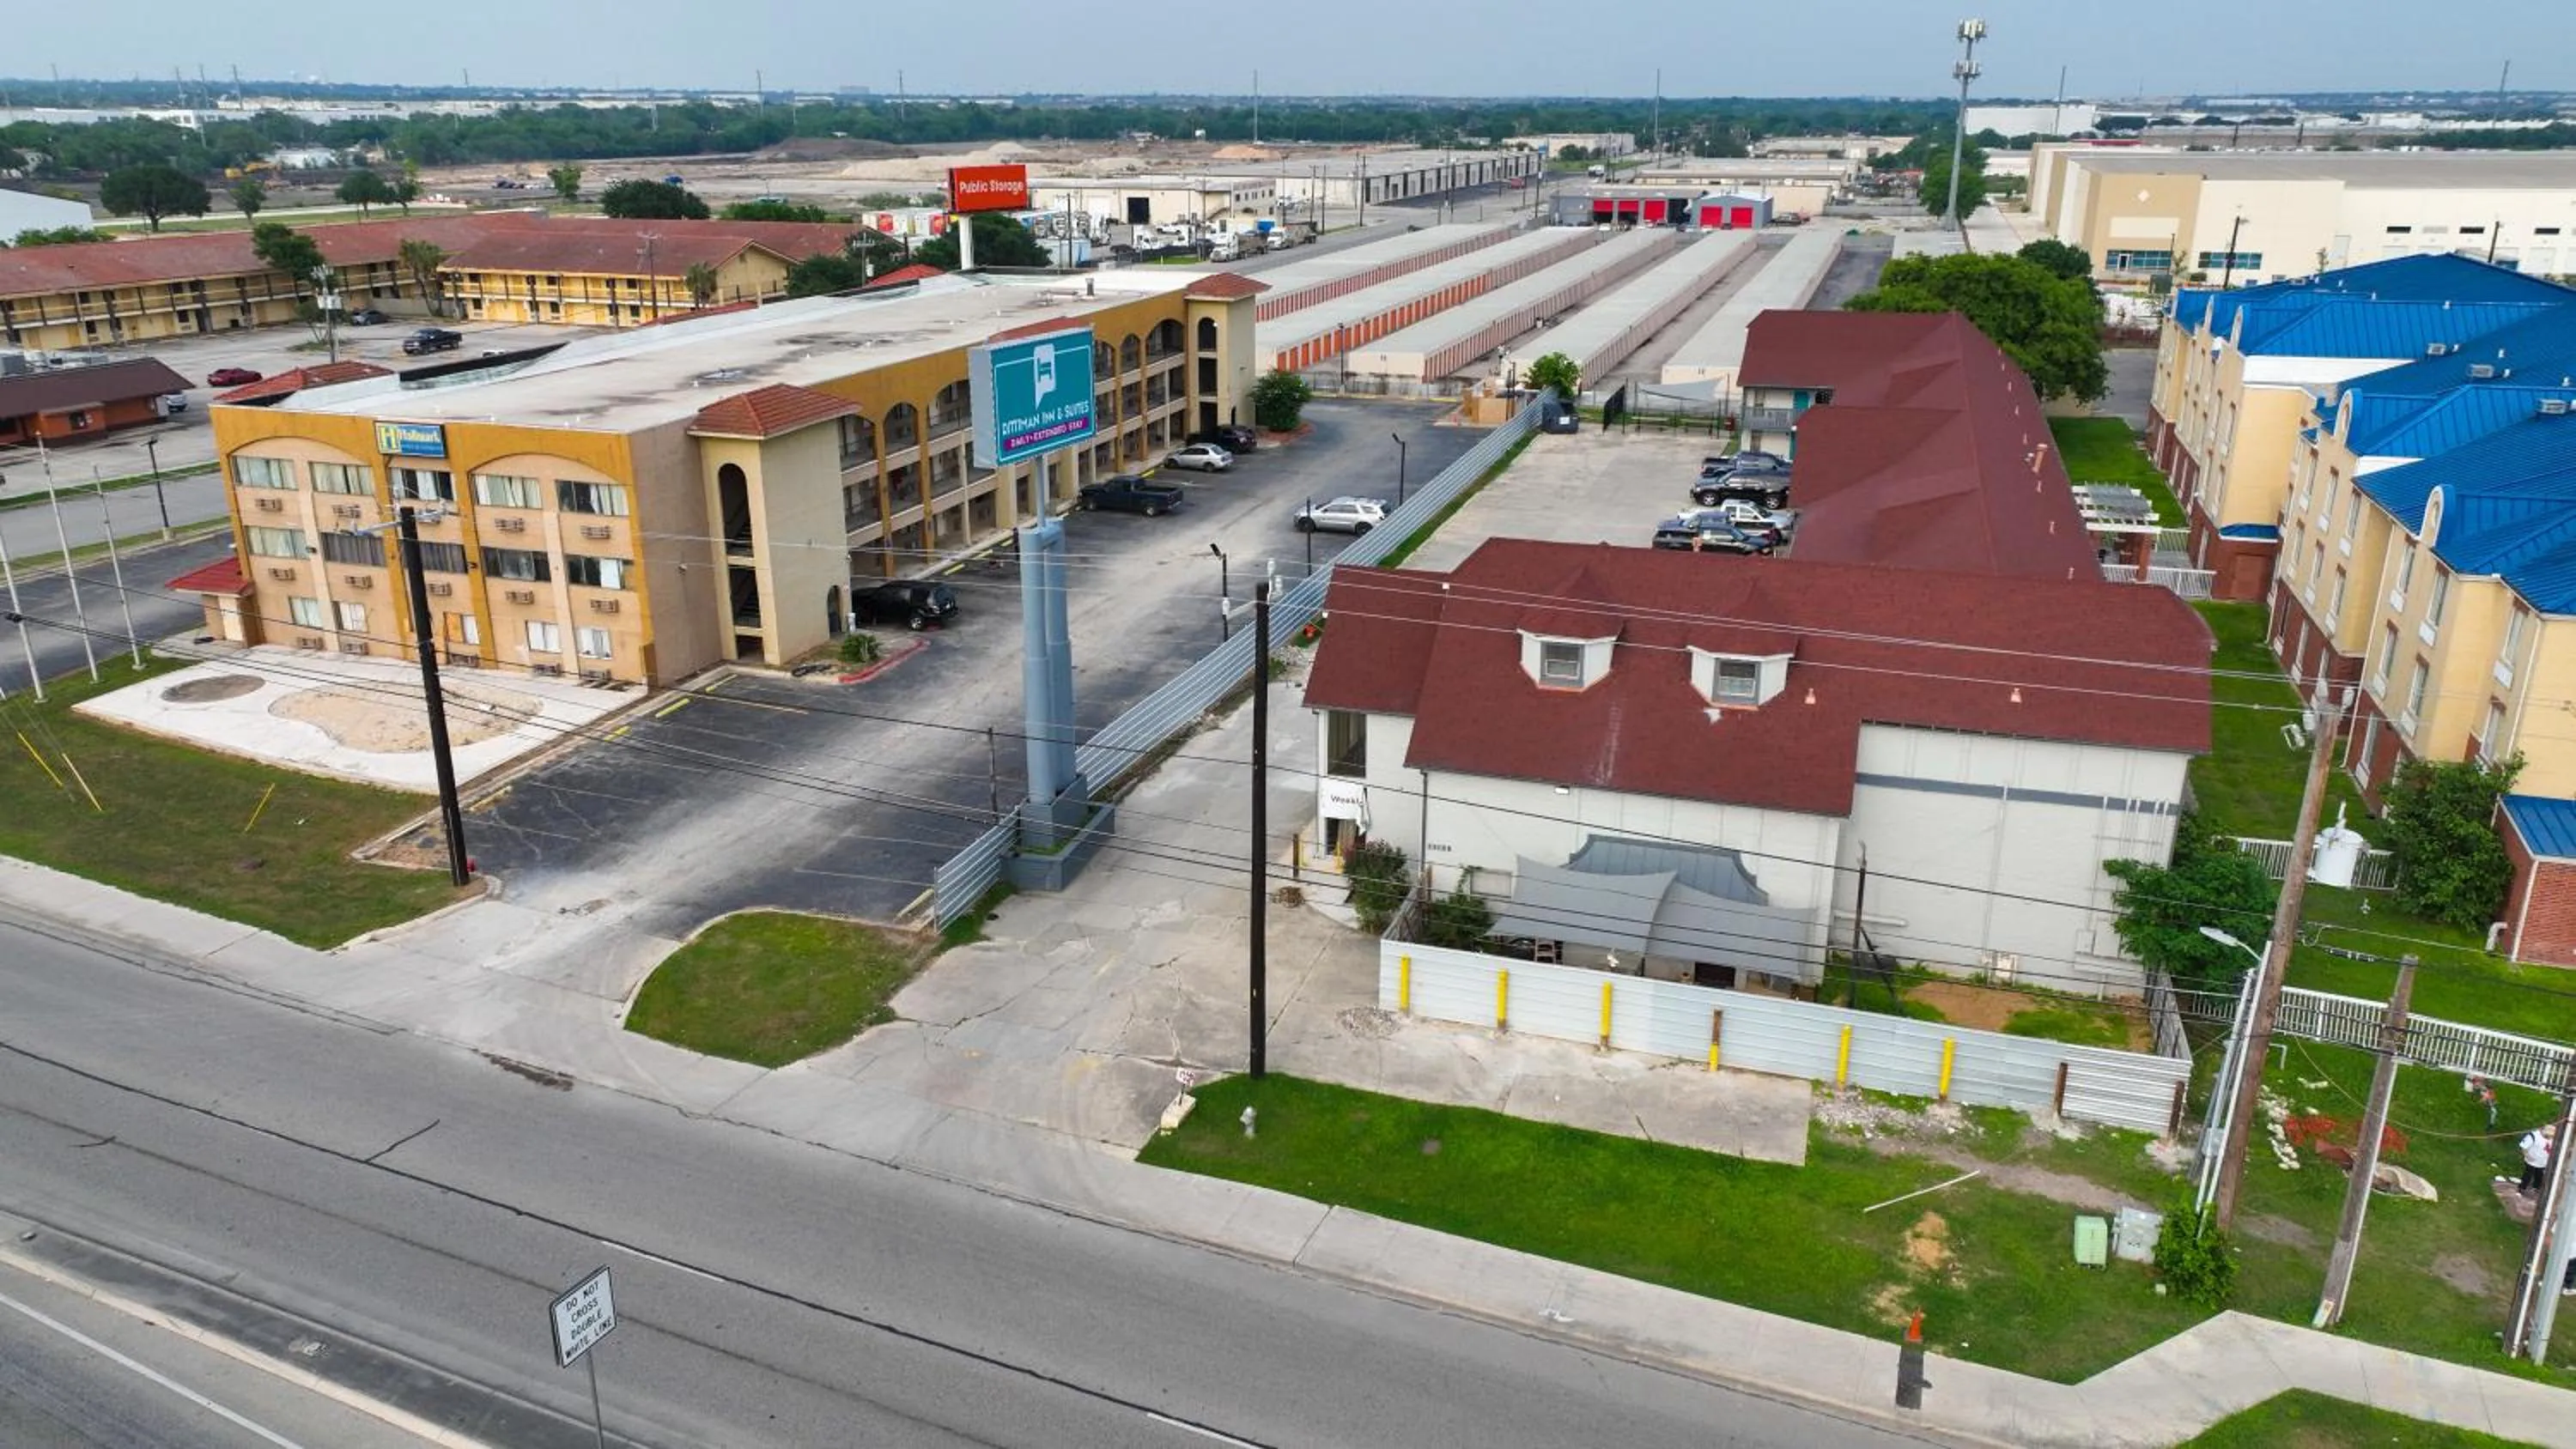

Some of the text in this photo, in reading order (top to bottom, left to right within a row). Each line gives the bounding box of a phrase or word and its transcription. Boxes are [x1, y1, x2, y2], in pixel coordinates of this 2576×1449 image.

[959, 179, 1024, 195] Public Storage
[1042, 409, 1055, 423] INN
[1057, 407, 1064, 420] &
[1064, 400, 1090, 418] SUITES
[567, 1281, 598, 1311] DO NOT
[571, 1297, 598, 1323] CROSS
[565, 1316, 612, 1358] WHITE LINE
[571, 1309, 603, 1339] DOUBLE
